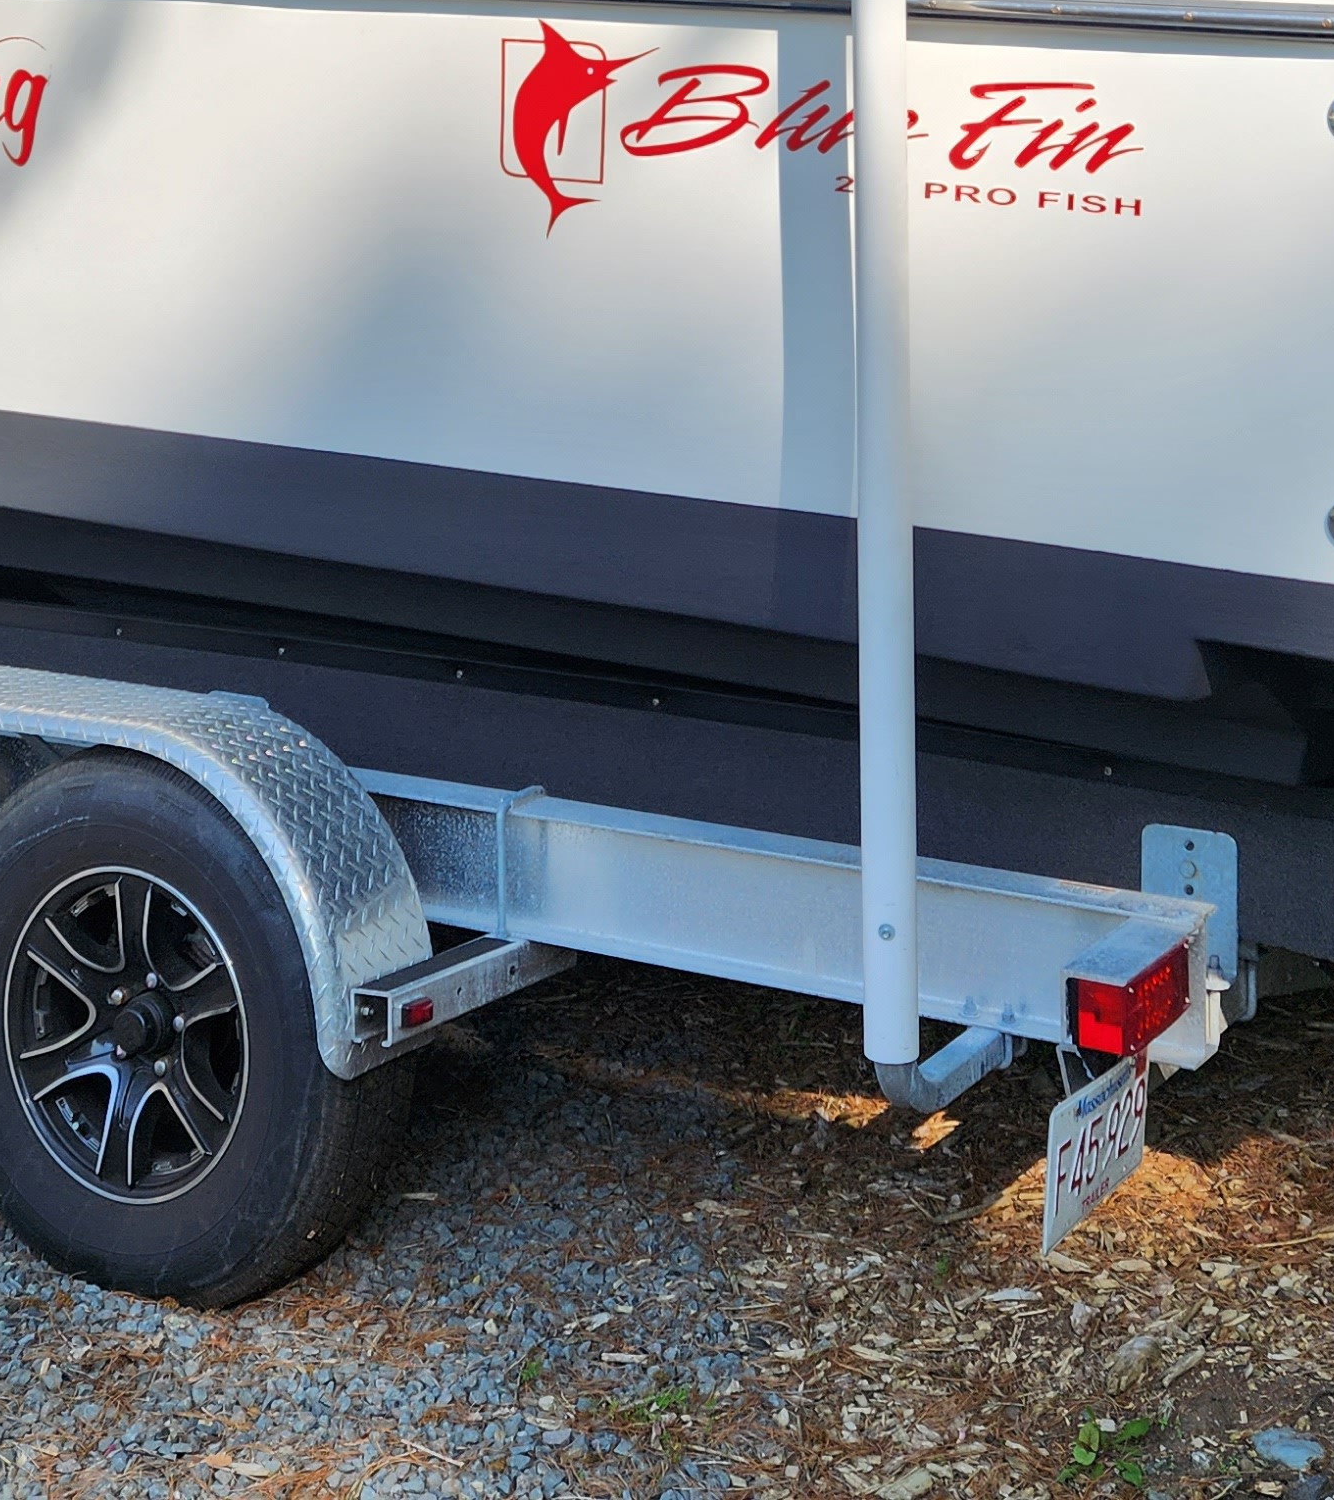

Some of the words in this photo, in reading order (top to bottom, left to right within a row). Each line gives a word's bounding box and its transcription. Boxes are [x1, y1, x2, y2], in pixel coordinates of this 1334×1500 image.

[948, 81, 1144, 173] Fin
[924, 182, 1017, 207] PRO
[1038, 190, 1142, 218] FISH
